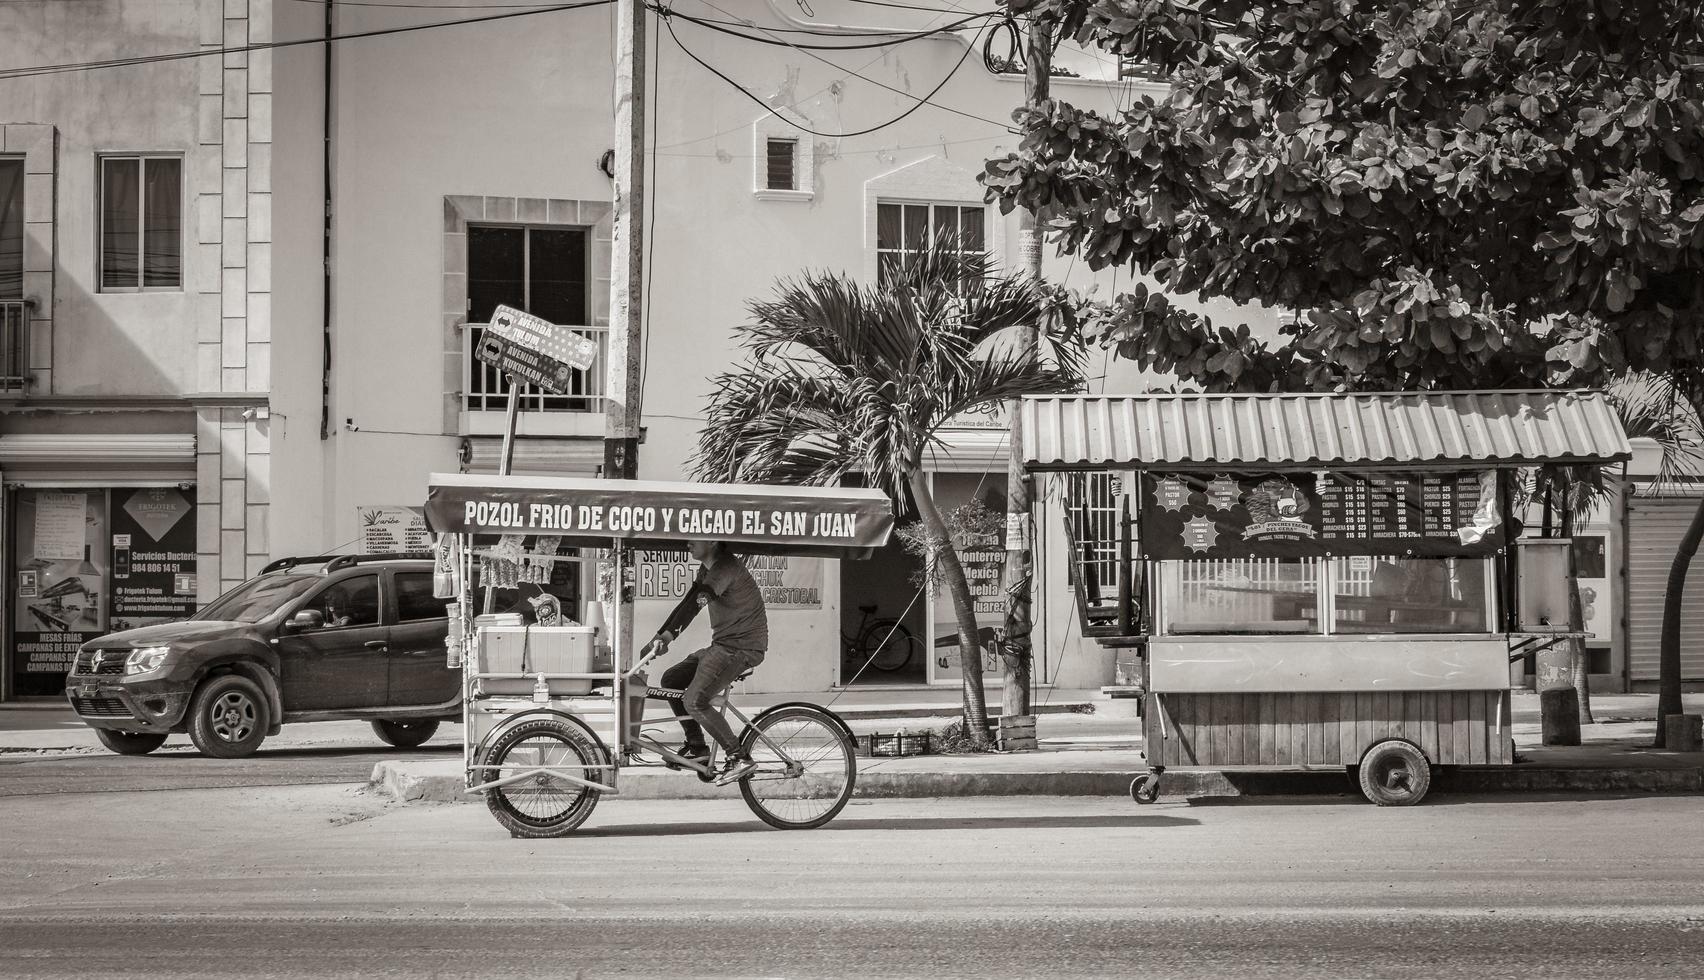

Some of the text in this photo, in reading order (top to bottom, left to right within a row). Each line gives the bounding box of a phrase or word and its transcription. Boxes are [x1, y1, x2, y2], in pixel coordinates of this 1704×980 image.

[516, 317, 553, 338] AVENIDA
[512, 327, 540, 346] TULUM
[507, 346, 539, 367] AVENIDA
[502, 356, 542, 382] KUKULKAN
[464, 501, 857, 538] POZOL FRIO DE COCO Y CACAO EL SAN JUAN
[132, 551, 166, 561] Servicios
[132, 563, 180, 573] 984 806 14 51
[968, 583, 998, 596] uebla
[40, 633, 62, 642] MESAS
[17, 643, 53, 652] CAMPANAS
[54, 643, 63, 652] DE
[30, 653, 66, 662] CAMPANAS
[27, 662, 63, 672] CAMPANAS
